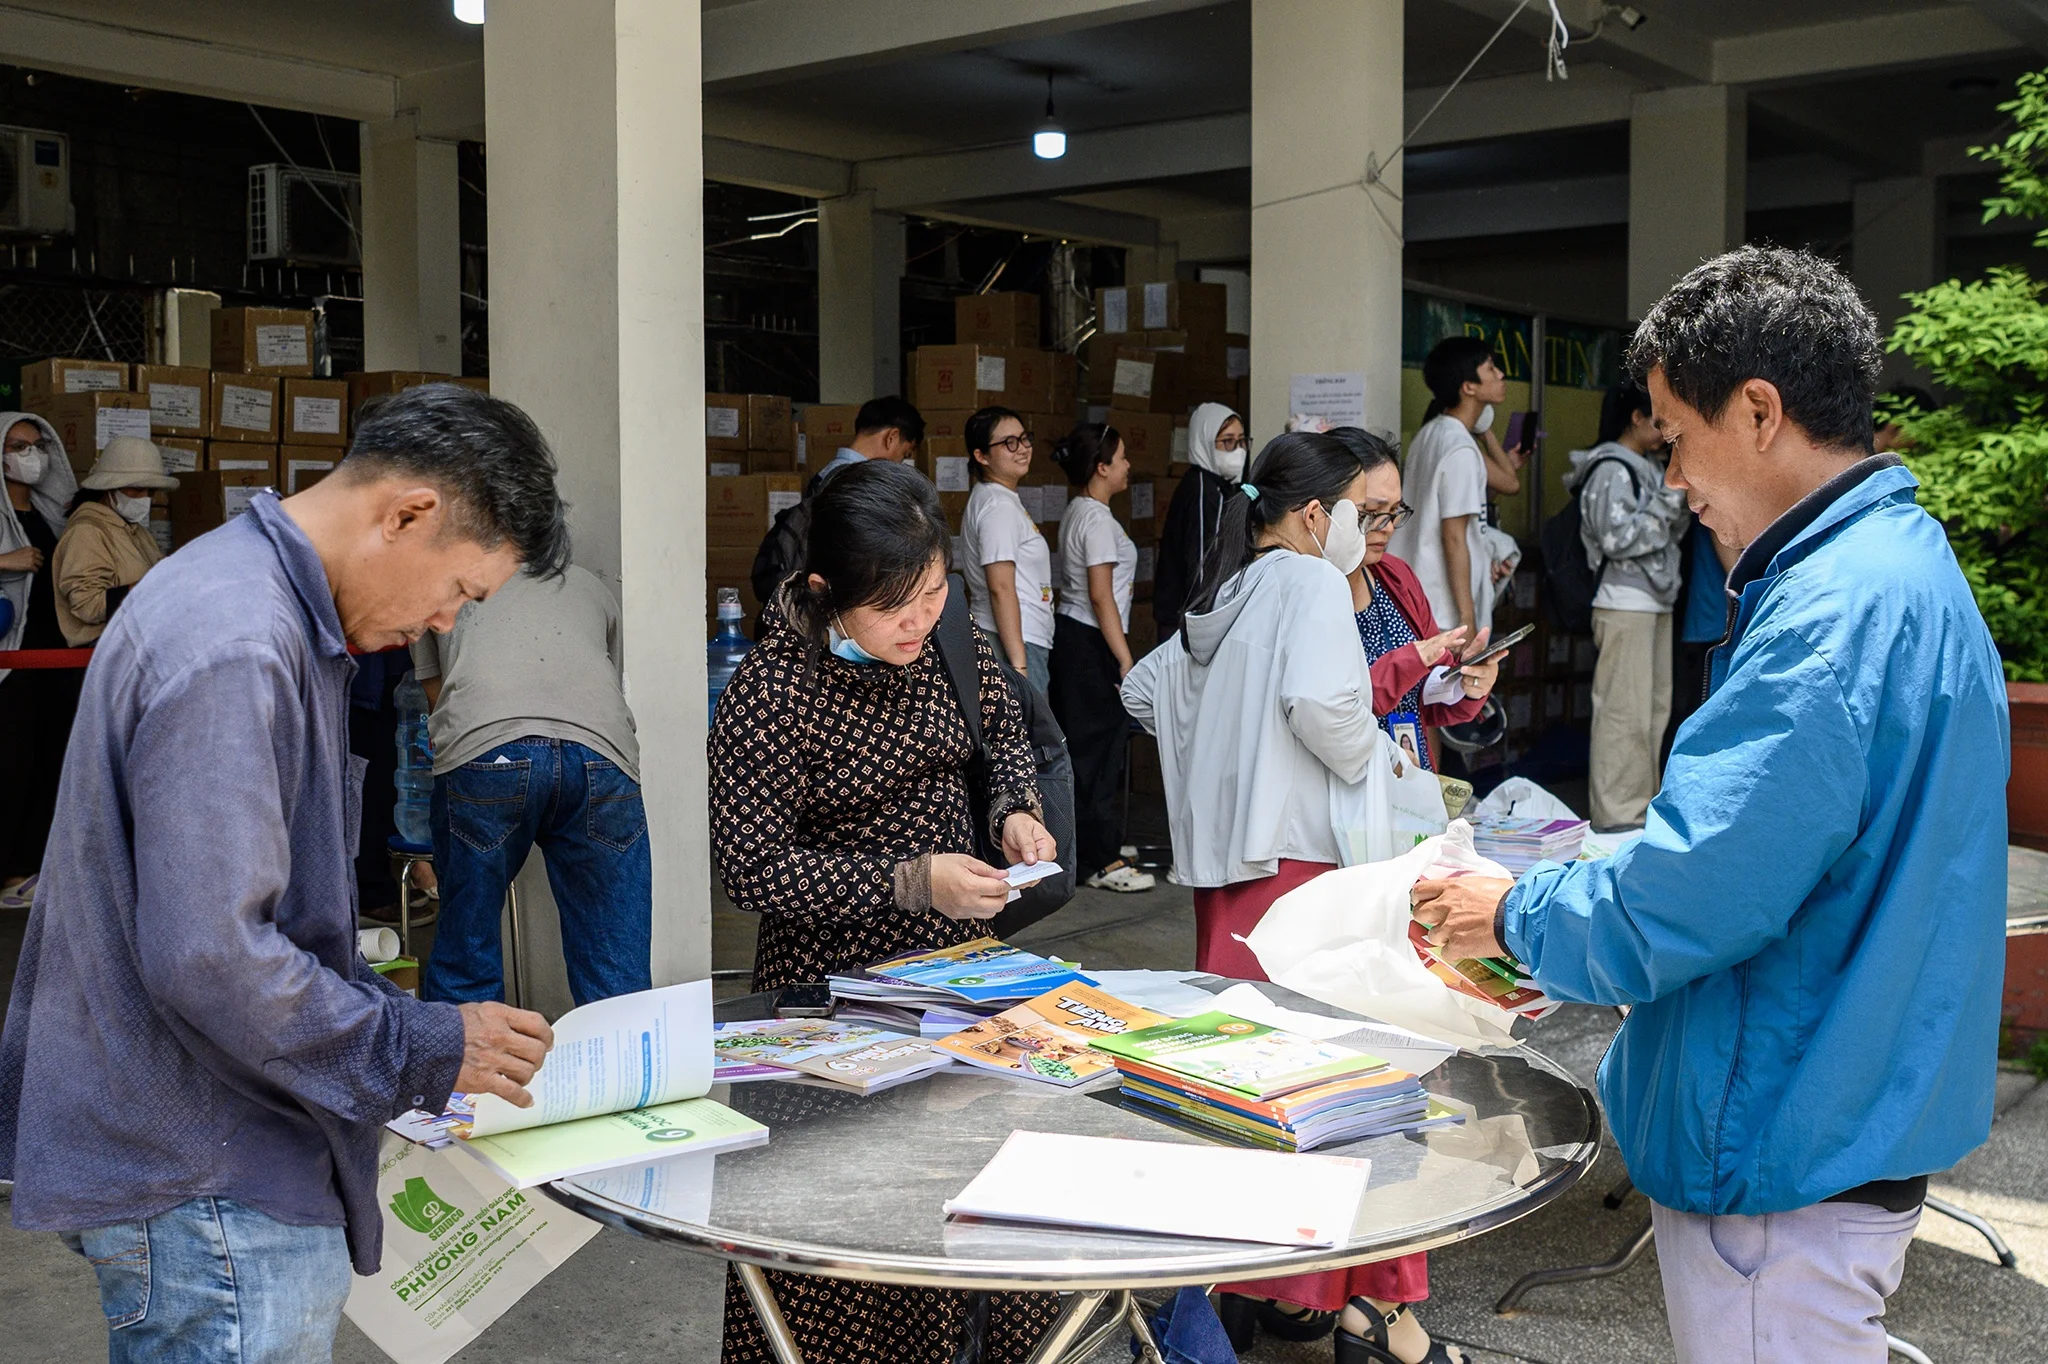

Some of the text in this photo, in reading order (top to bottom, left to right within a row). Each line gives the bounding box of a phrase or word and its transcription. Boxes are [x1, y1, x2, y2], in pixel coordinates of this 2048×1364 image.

[390, 1275, 408, 1290] CÔNG
[406, 1269, 415, 1277] TY
[488, 1196, 504, 1209] GIÁO
[502, 1186, 516, 1199] DỤC
[396, 1192, 526, 1301] PHƯƠNG NAM
[428, 1208, 464, 1241] SEDIDCO
[477, 1208, 535, 1257] phuongnam.edu.vn
